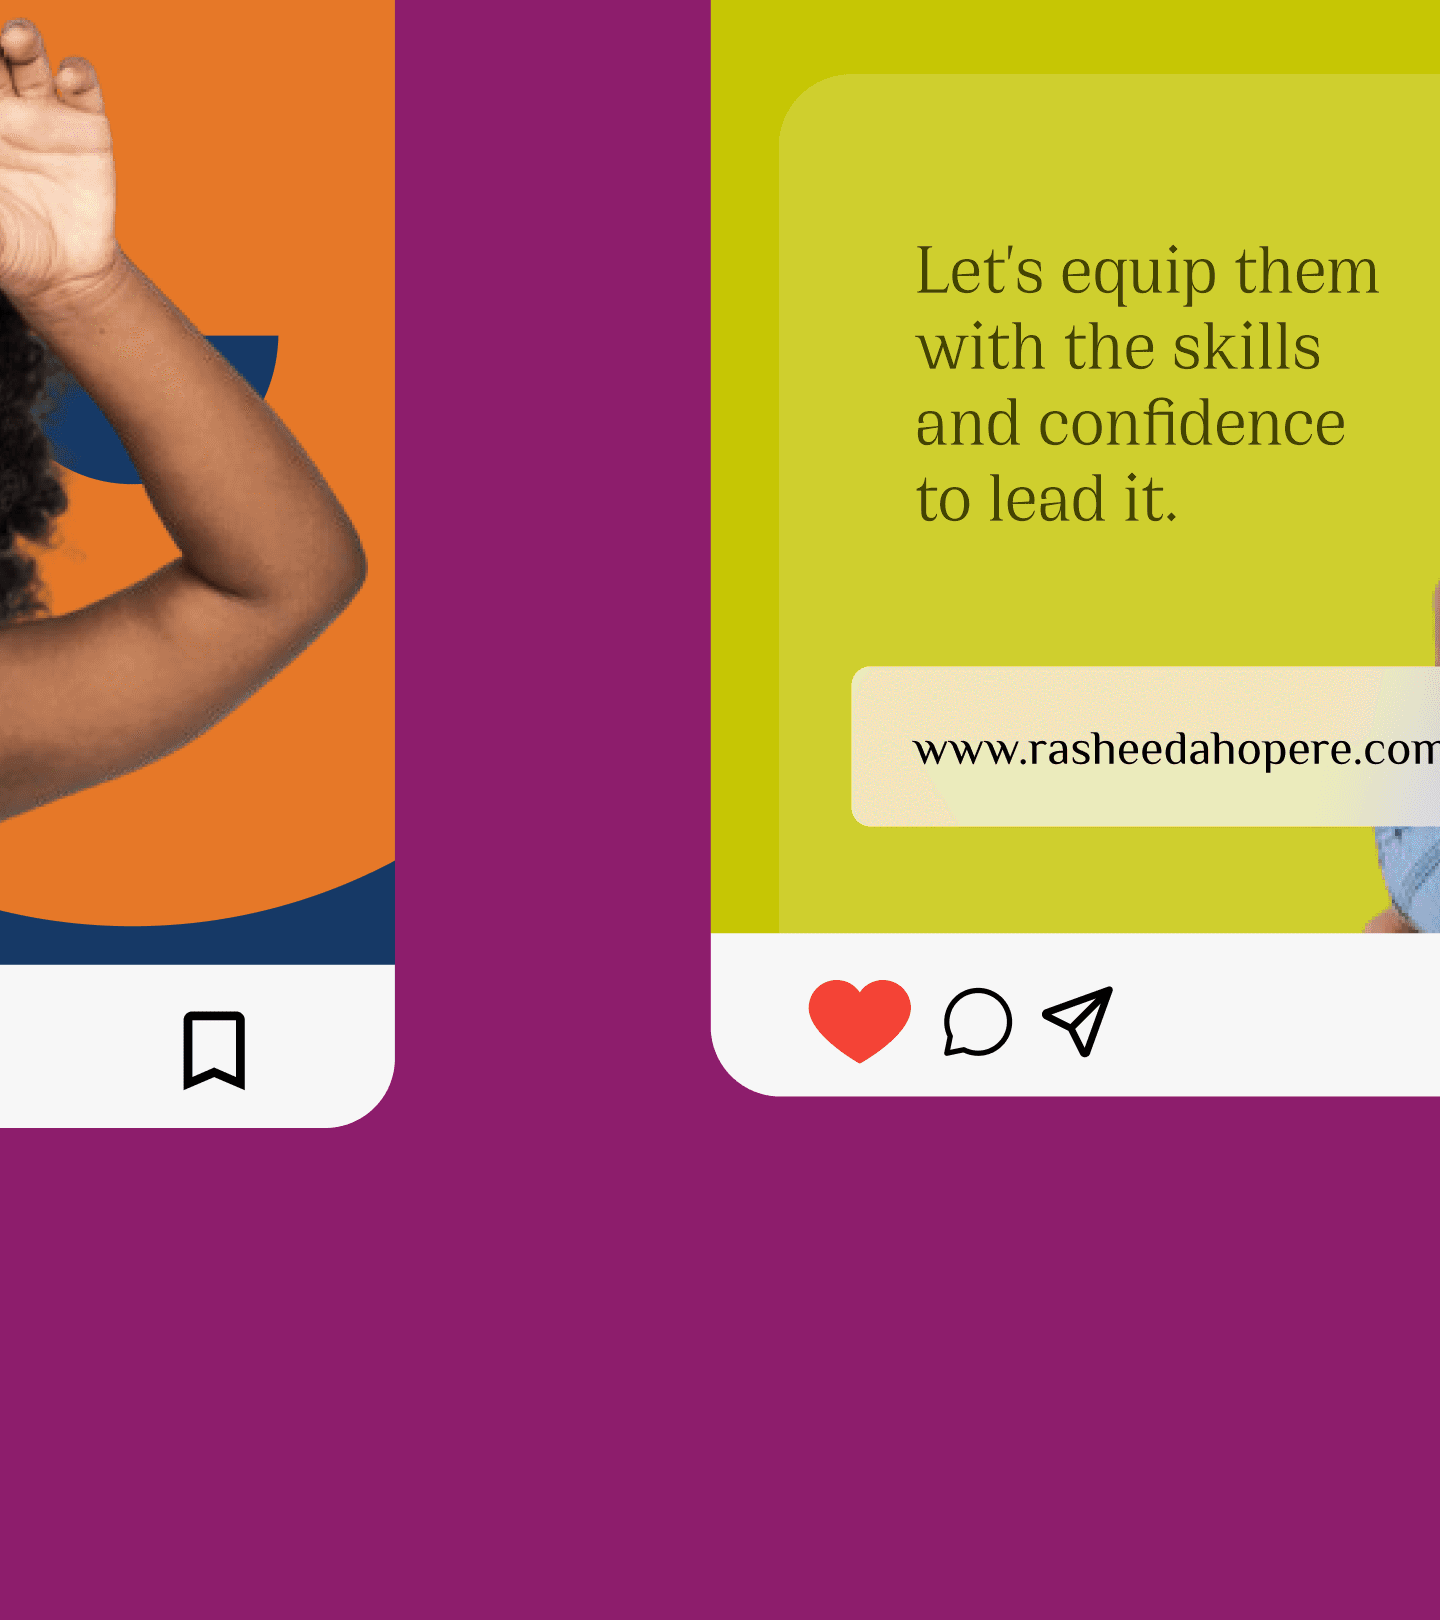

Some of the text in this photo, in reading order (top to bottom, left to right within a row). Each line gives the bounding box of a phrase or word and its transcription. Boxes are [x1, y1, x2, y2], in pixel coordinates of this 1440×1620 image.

[916, 244, 1380, 308] Let's equip them
[914, 320, 1320, 370] with the skills
[917, 396, 1345, 446] and confidence
[916, 472, 1176, 522] to lead it.
